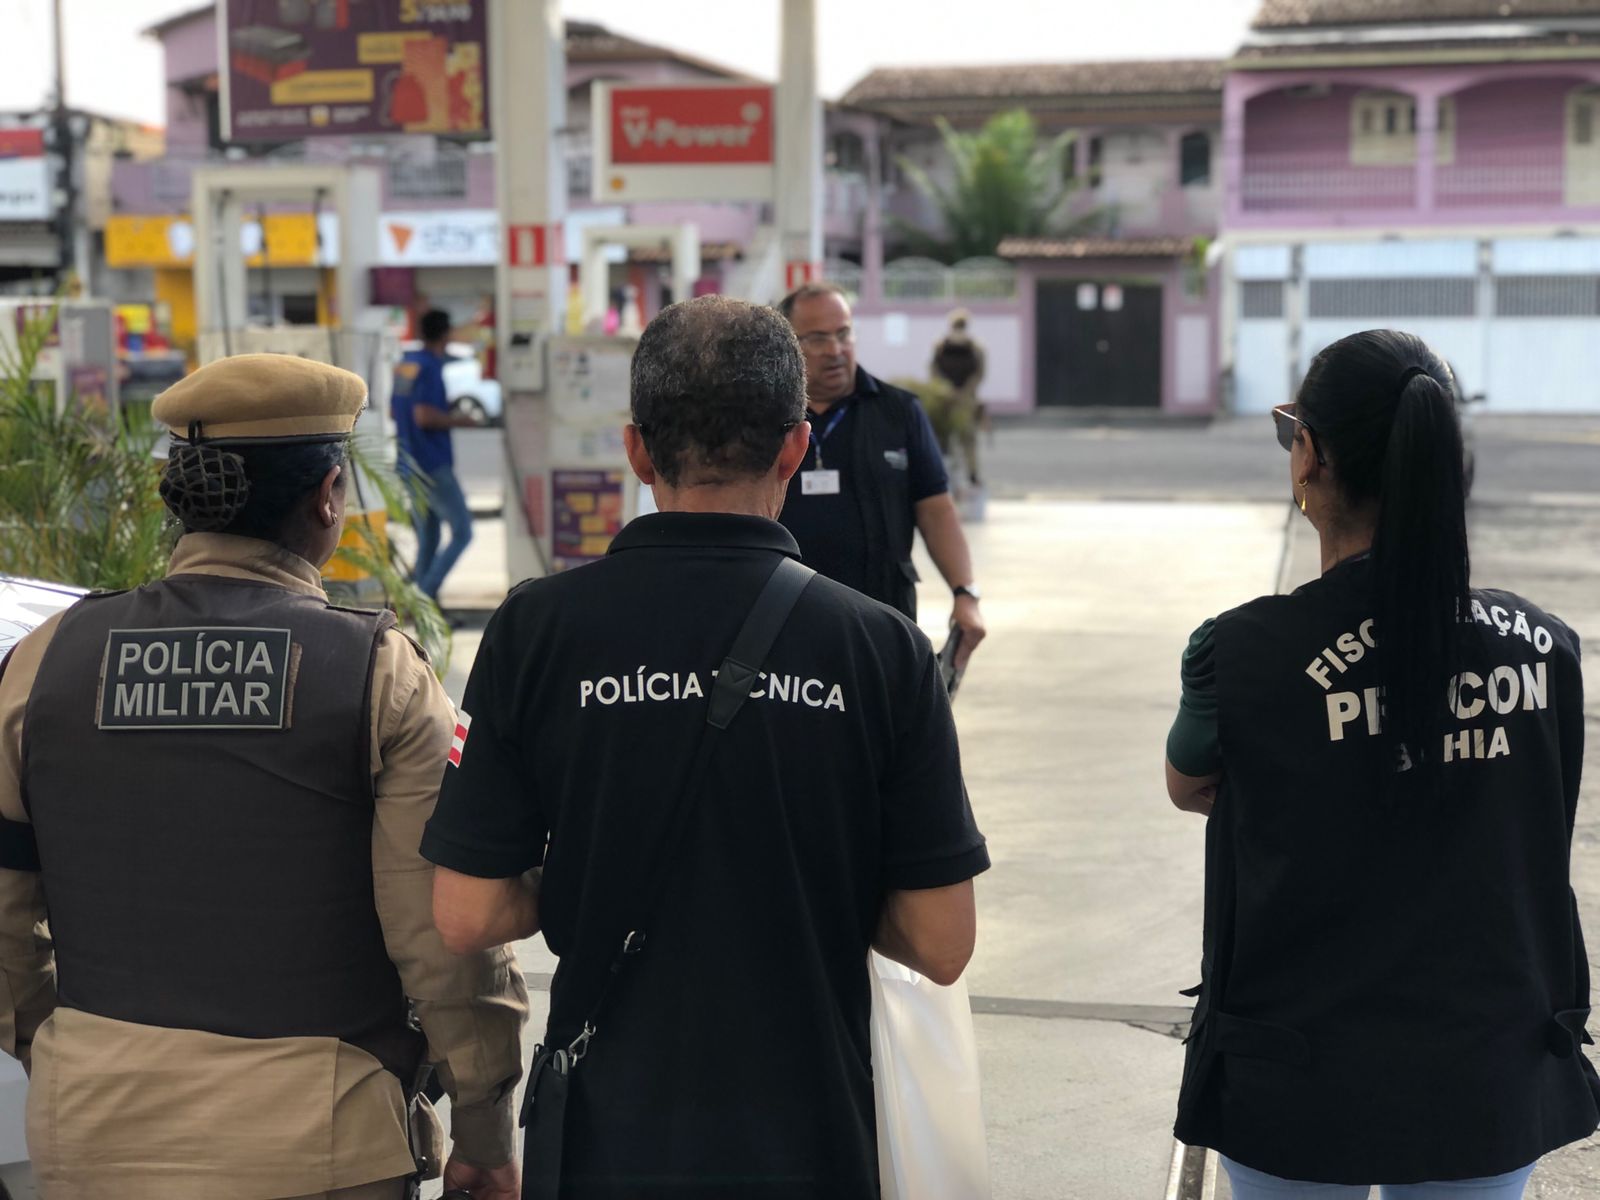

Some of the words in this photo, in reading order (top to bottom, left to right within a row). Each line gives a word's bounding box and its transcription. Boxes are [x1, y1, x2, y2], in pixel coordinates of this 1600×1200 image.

[117, 632, 274, 676] POLÍCIA
[113, 681, 271, 717] MILITAR
[580, 665, 704, 708] POLÍCIA
[712, 670, 846, 712] CNICA
[1397, 726, 1510, 772] HIA
